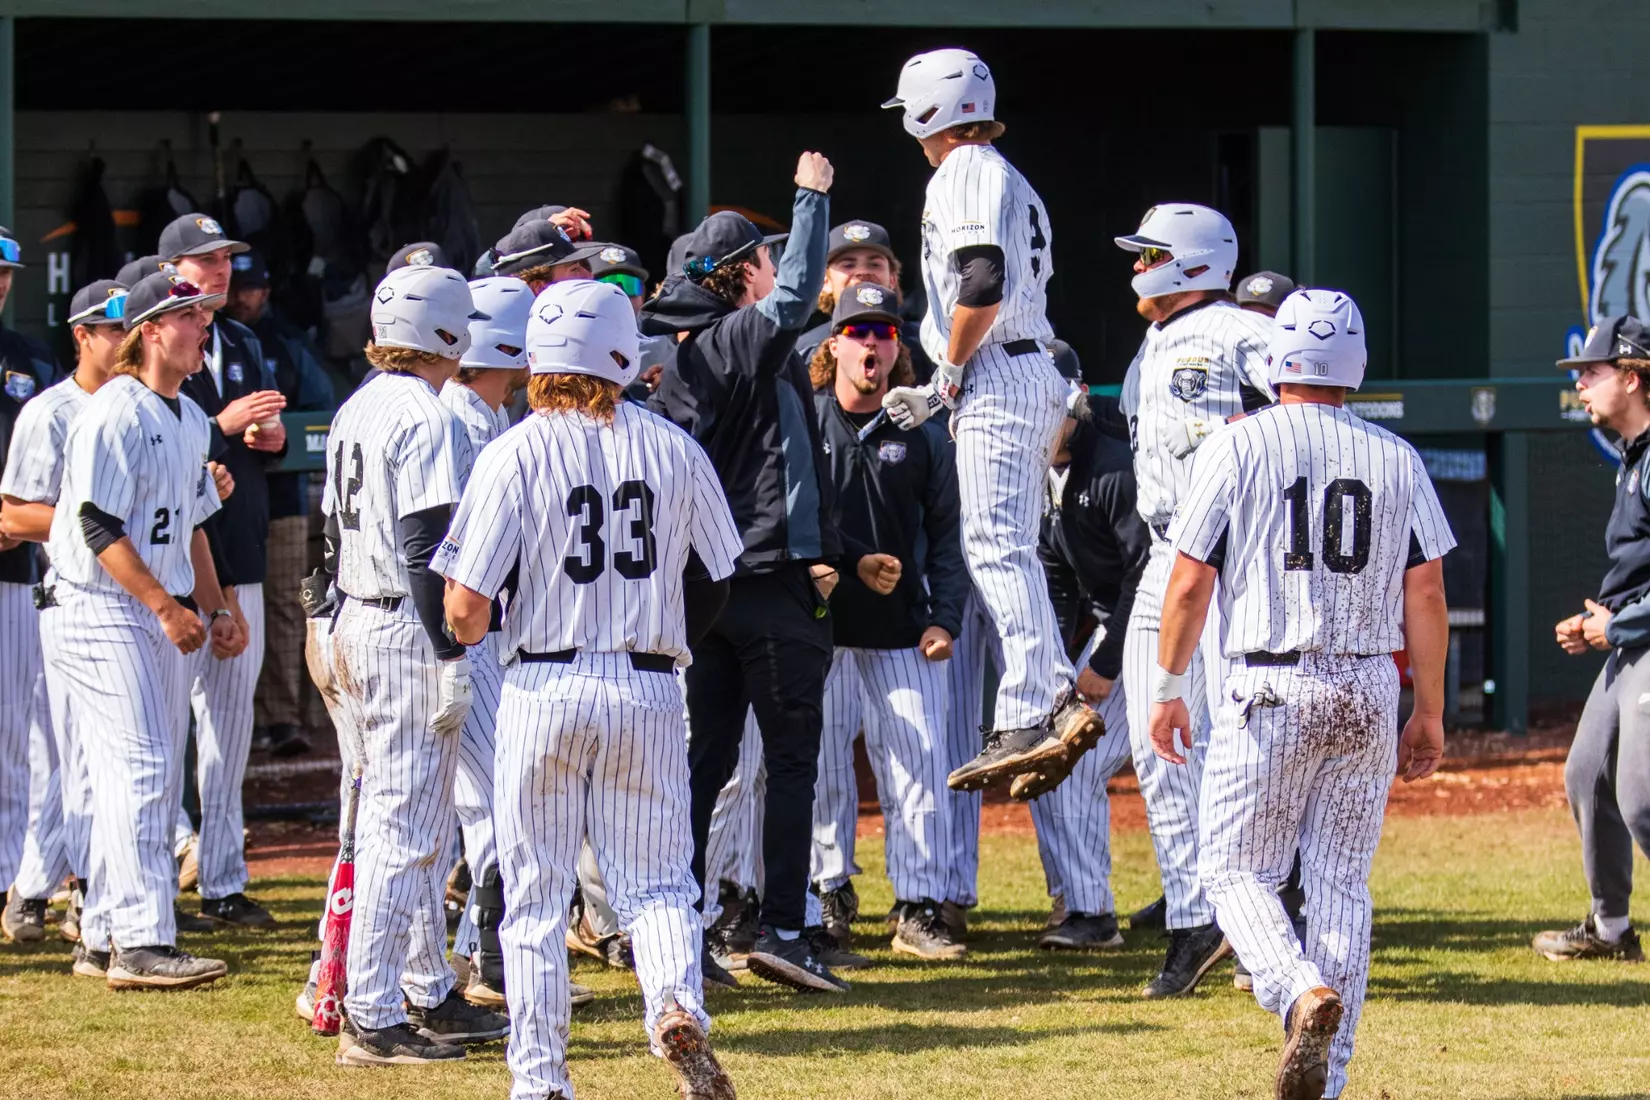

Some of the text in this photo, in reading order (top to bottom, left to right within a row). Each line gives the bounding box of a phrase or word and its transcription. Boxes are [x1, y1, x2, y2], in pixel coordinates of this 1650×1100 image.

[951, 224, 985, 233] HORIZON
[1313, 361, 1329, 377] 10
[150, 506, 180, 545] 2
[563, 479, 658, 585] 33
[1283, 475, 1373, 575] 10
